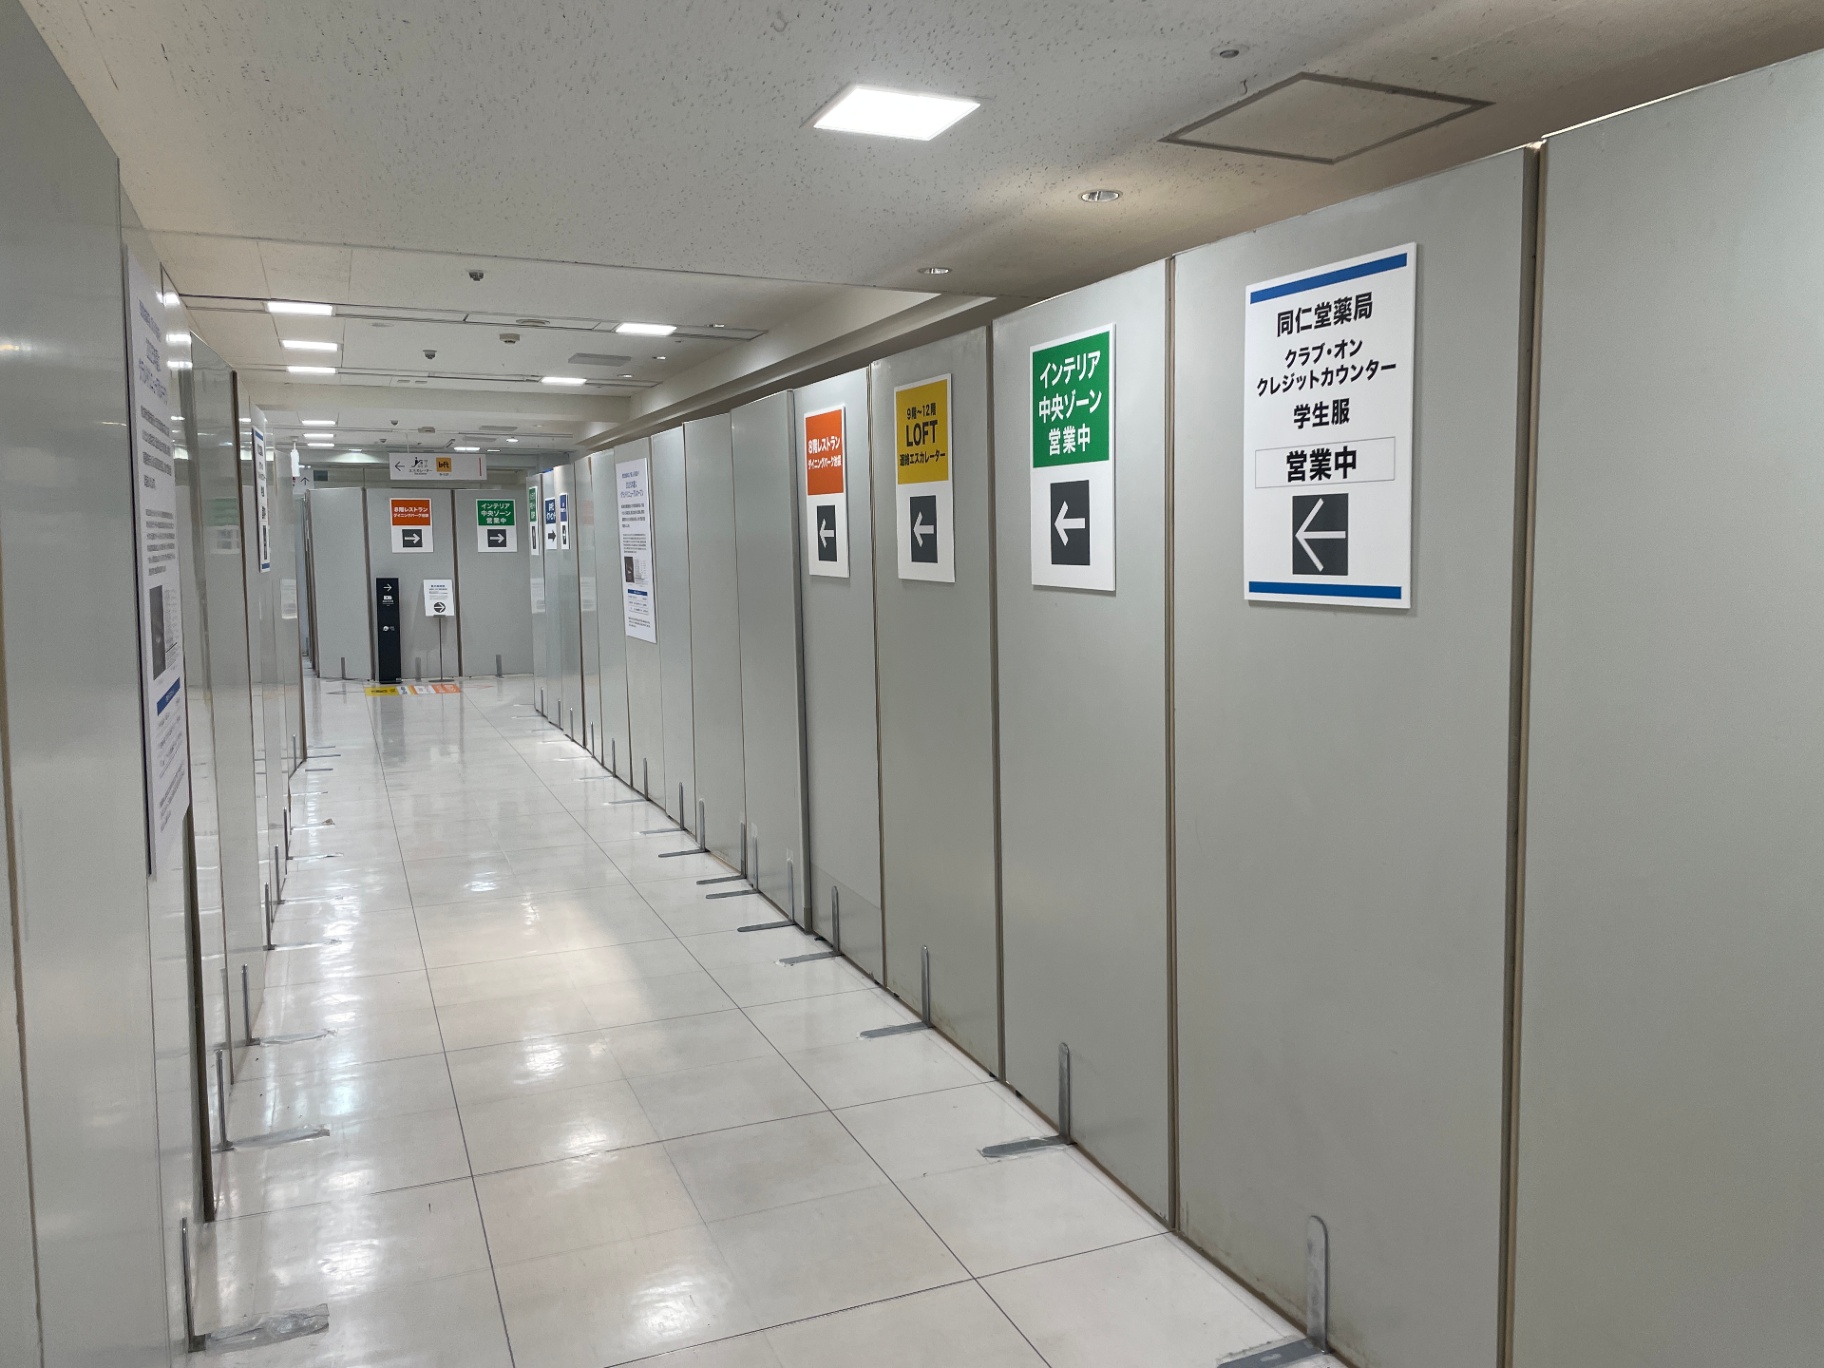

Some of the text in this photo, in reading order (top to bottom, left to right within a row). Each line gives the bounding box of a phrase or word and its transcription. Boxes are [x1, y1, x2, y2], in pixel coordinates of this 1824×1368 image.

[1277, 292, 1373, 337] 同仁堂薬局
[1040, 350, 1101, 389] インテリア
[1285, 339, 1363, 369] クラブ・オン
[1257, 359, 1397, 397] クレジットカウンター
[1039, 389, 1102, 424] 中央ゾーン
[1293, 398, 1350, 430] 学生服
[808, 435, 841, 454] 8階レストラン
[906, 419, 938, 447] LOFT
[1048, 423, 1091, 456] 営業中
[1286, 445, 1357, 483] 営業中
